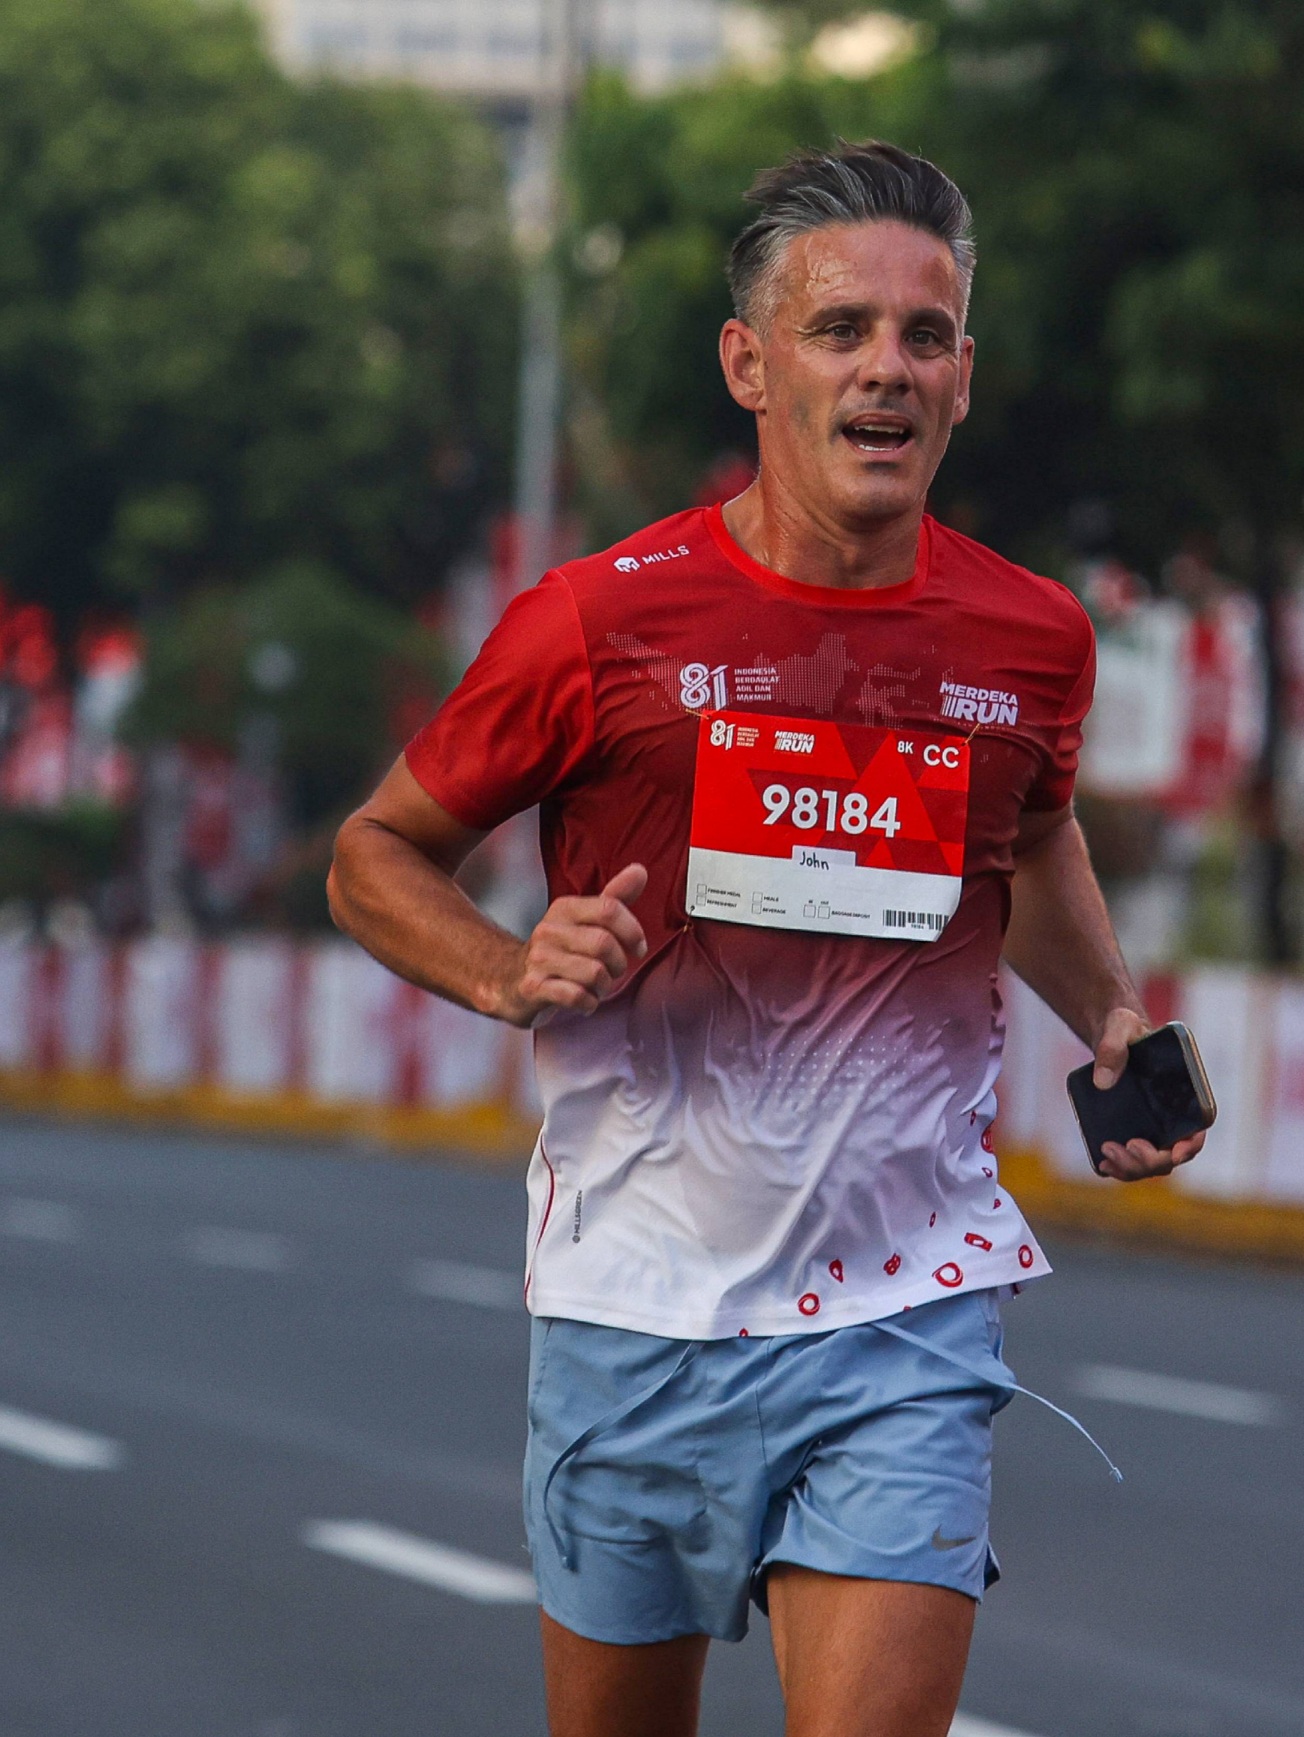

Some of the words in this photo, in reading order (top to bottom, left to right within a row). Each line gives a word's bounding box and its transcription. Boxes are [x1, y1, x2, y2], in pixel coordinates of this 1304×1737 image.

[642, 545, 690, 565] MILLS
[734, 667, 777, 675] INDONESIA
[735, 676, 780, 684] BERDAULAT
[679, 662, 728, 711] 81
[939, 682, 1018, 706] MERDEKA
[736, 693, 772, 702] MAKMUR
[953, 698, 1019, 726] RUN
[710, 719, 736, 751] 81
[774, 730, 815, 742] MERDEKA
[780, 739, 814, 754] RUN
[897, 740, 914, 754] 8K
[923, 744, 959, 769] CC
[762, 783, 901, 838] 98184
[799, 851, 830, 871] John
